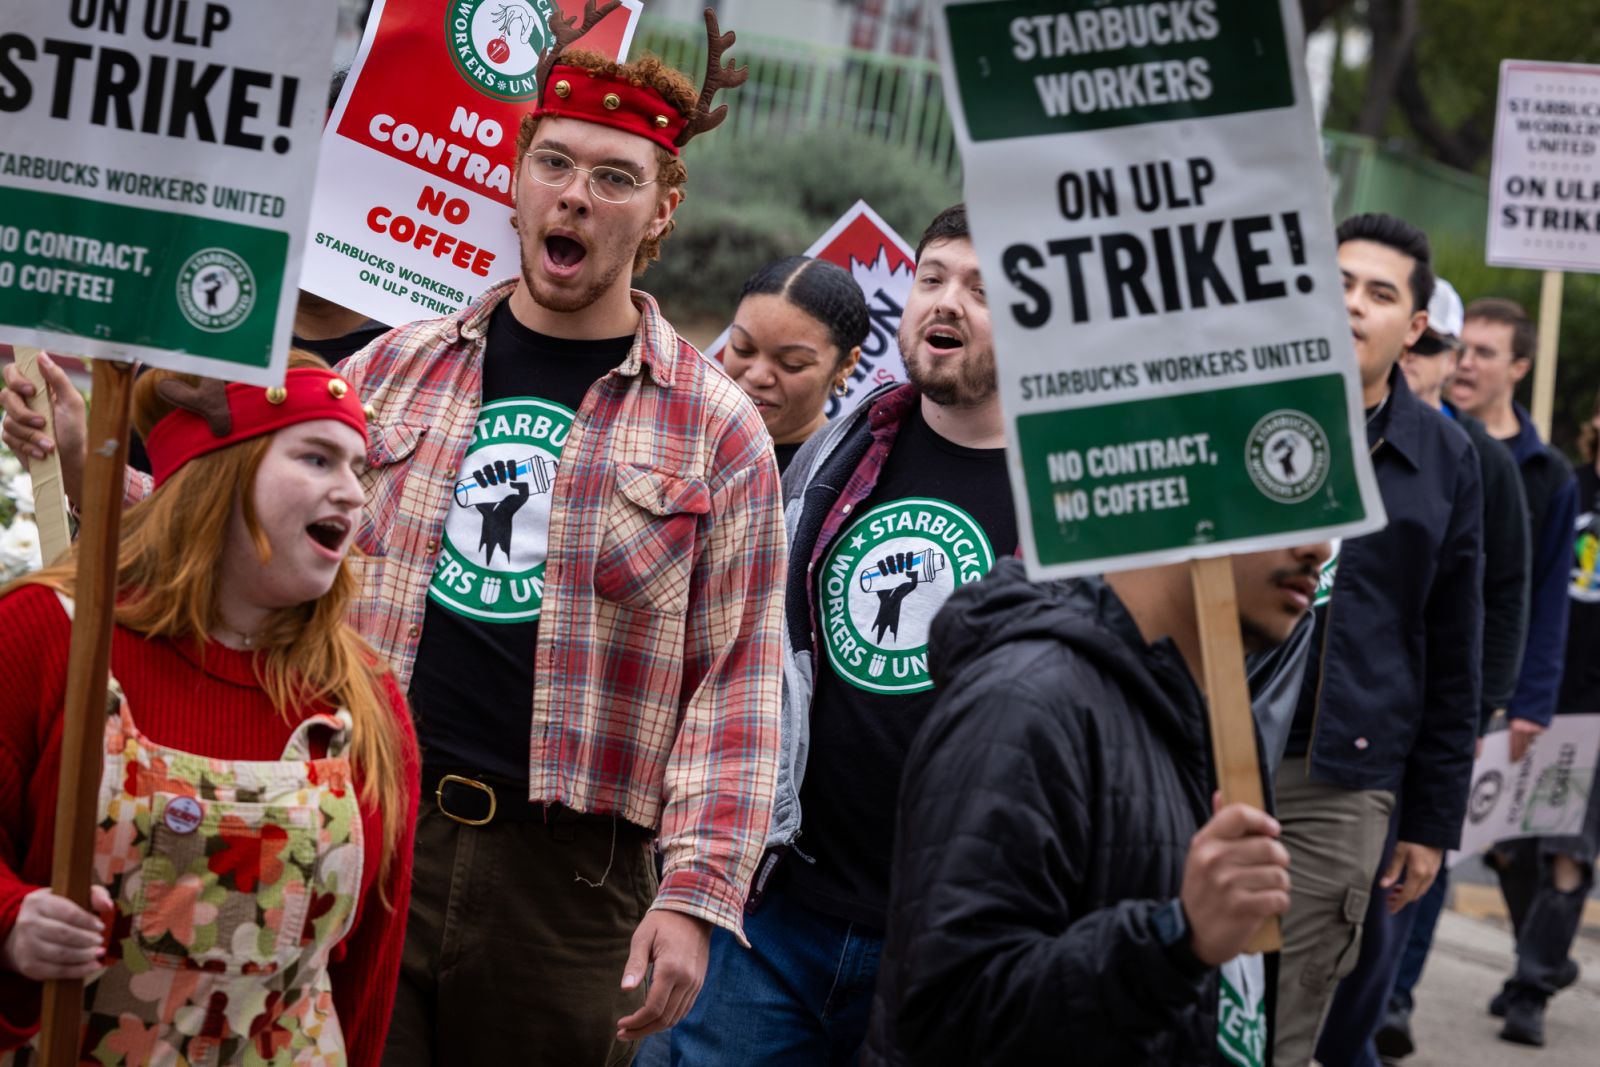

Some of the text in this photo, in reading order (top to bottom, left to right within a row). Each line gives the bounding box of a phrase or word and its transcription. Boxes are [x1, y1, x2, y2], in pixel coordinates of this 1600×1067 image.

[143, 0, 232, 48] ULP
[455, 2, 496, 87] WORKERS
[1010, 0, 1220, 60] STARBUCKS
[0, 32, 299, 155] STRIKE!
[1035, 58, 1213, 117] WORKERS
[450, 106, 503, 148] NO
[106, 168, 208, 205] WORKERS
[212, 184, 286, 219] UNITED
[416, 186, 470, 225] NO
[1057, 157, 1215, 221] ON ULP
[1506, 175, 1545, 198] ON
[24, 228, 151, 277] CONTRACT,
[315, 232, 465, 303] STARBUCKS WORKERS
[366, 206, 497, 278] COFFEE
[19, 264, 114, 303] COFFEE!
[359, 270, 381, 285] ON
[382, 278, 409, 297] ULP
[1002, 211, 1315, 330] STRIKE!
[1020, 338, 1332, 401] STARBUCKS WORKERS UNITED
[1048, 433, 1219, 483] NO CONTRACT,
[1054, 476, 1190, 523] NO COFFEE!
[827, 553, 868, 667] WORKERS
